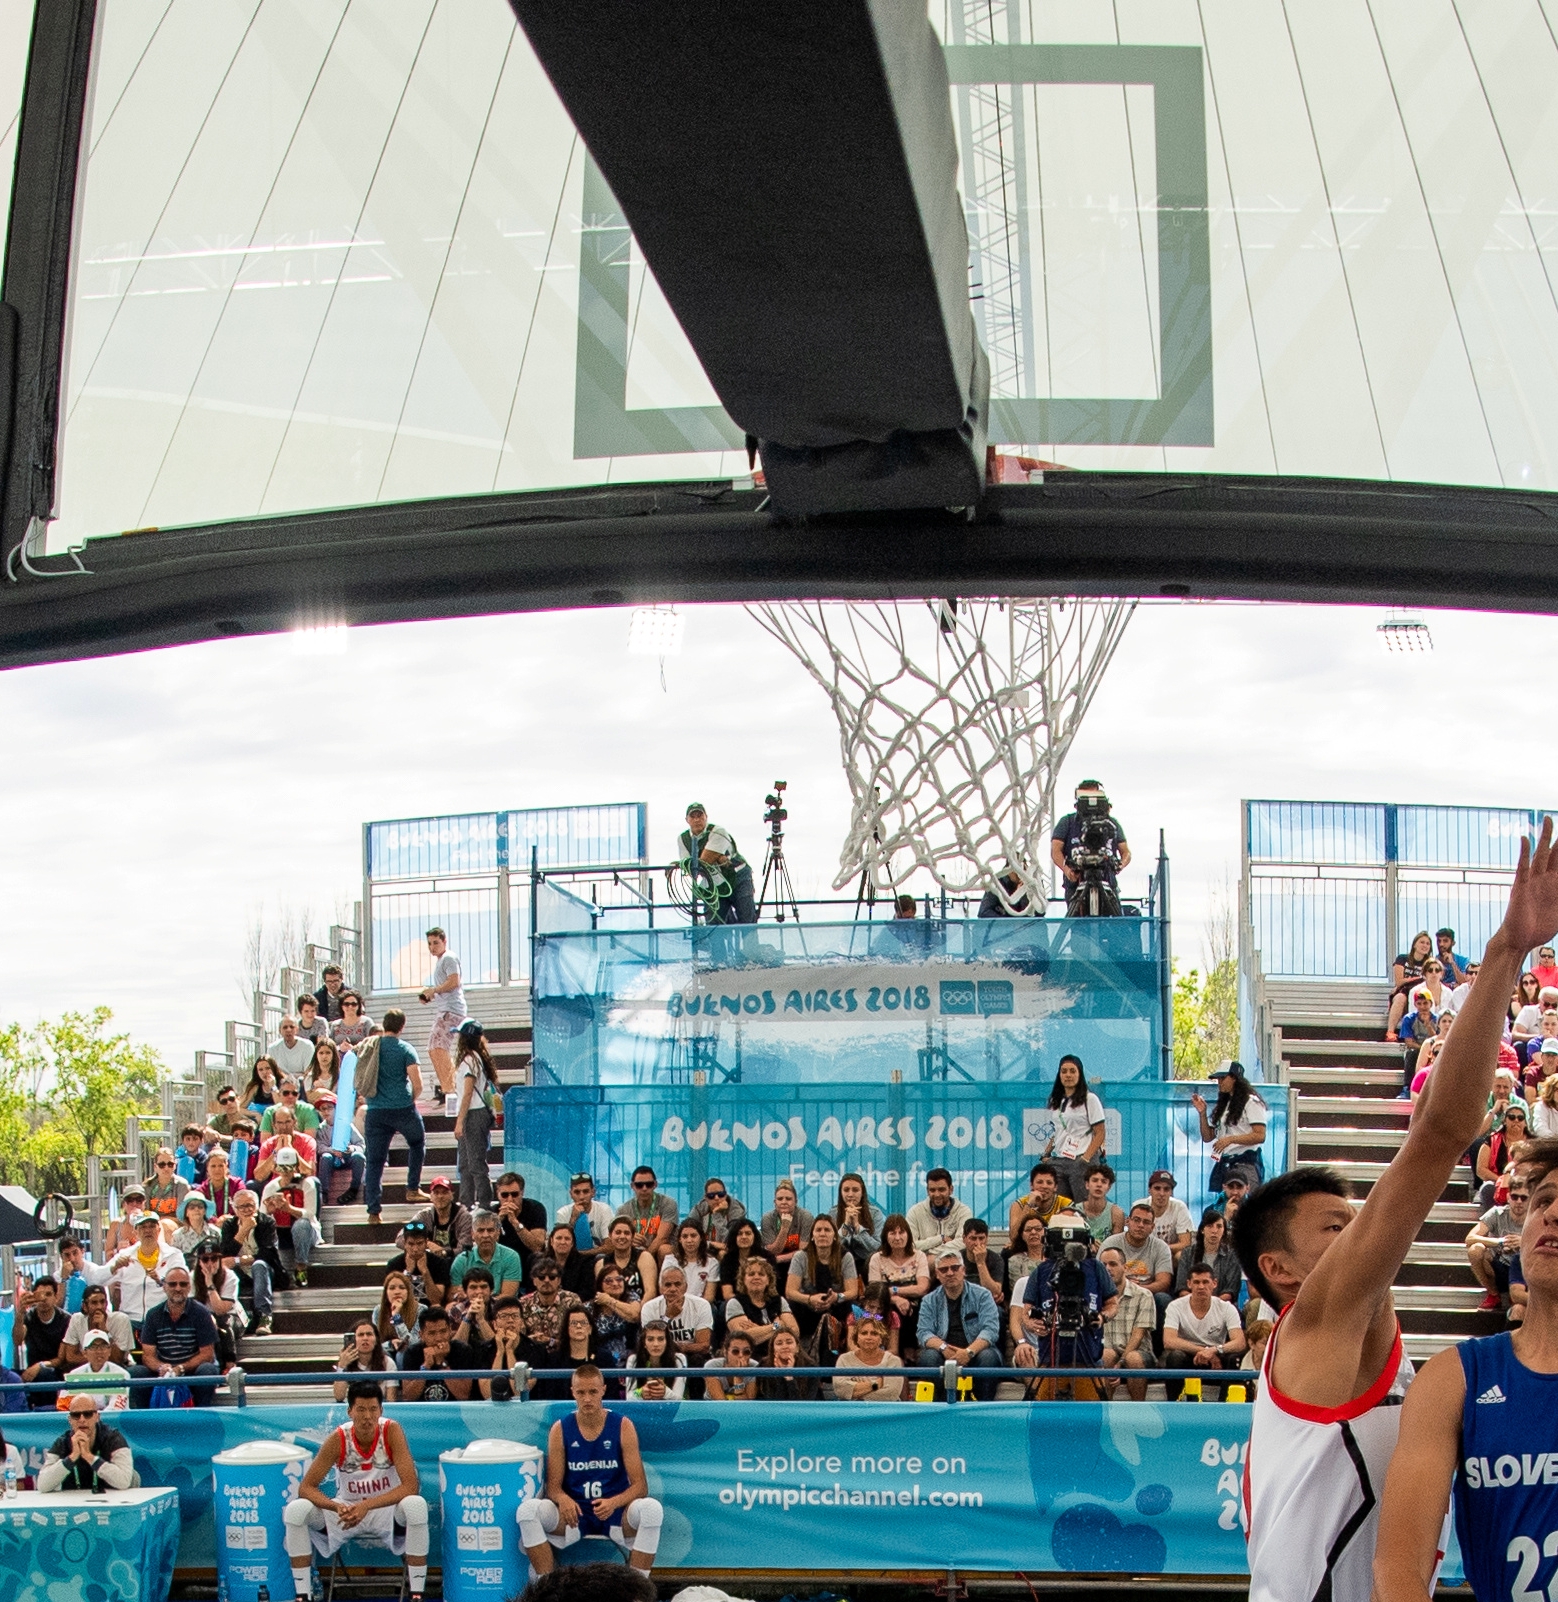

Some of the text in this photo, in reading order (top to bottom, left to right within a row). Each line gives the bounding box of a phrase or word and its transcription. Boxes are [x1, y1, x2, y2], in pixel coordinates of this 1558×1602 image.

[522, 817, 569, 840] 2018
[666, 985, 932, 1018] BUENOS AIRES 2018
[660, 1114, 1013, 1153] BUENOS AIRES 2018
[789, 1163, 846, 1188] Feel
[737, 1448, 966, 1480] Explore more on
[347, 1476, 391, 1494] CHINA
[455, 1483, 502, 1497] BUENOS
[582, 1481, 602, 1499] 16
[461, 1497, 495, 1510] AIRES
[718, 1482, 984, 1511] olympicchannel.com
[229, 1509, 260, 1524] 2018
[461, 1509, 495, 1524] 2018
